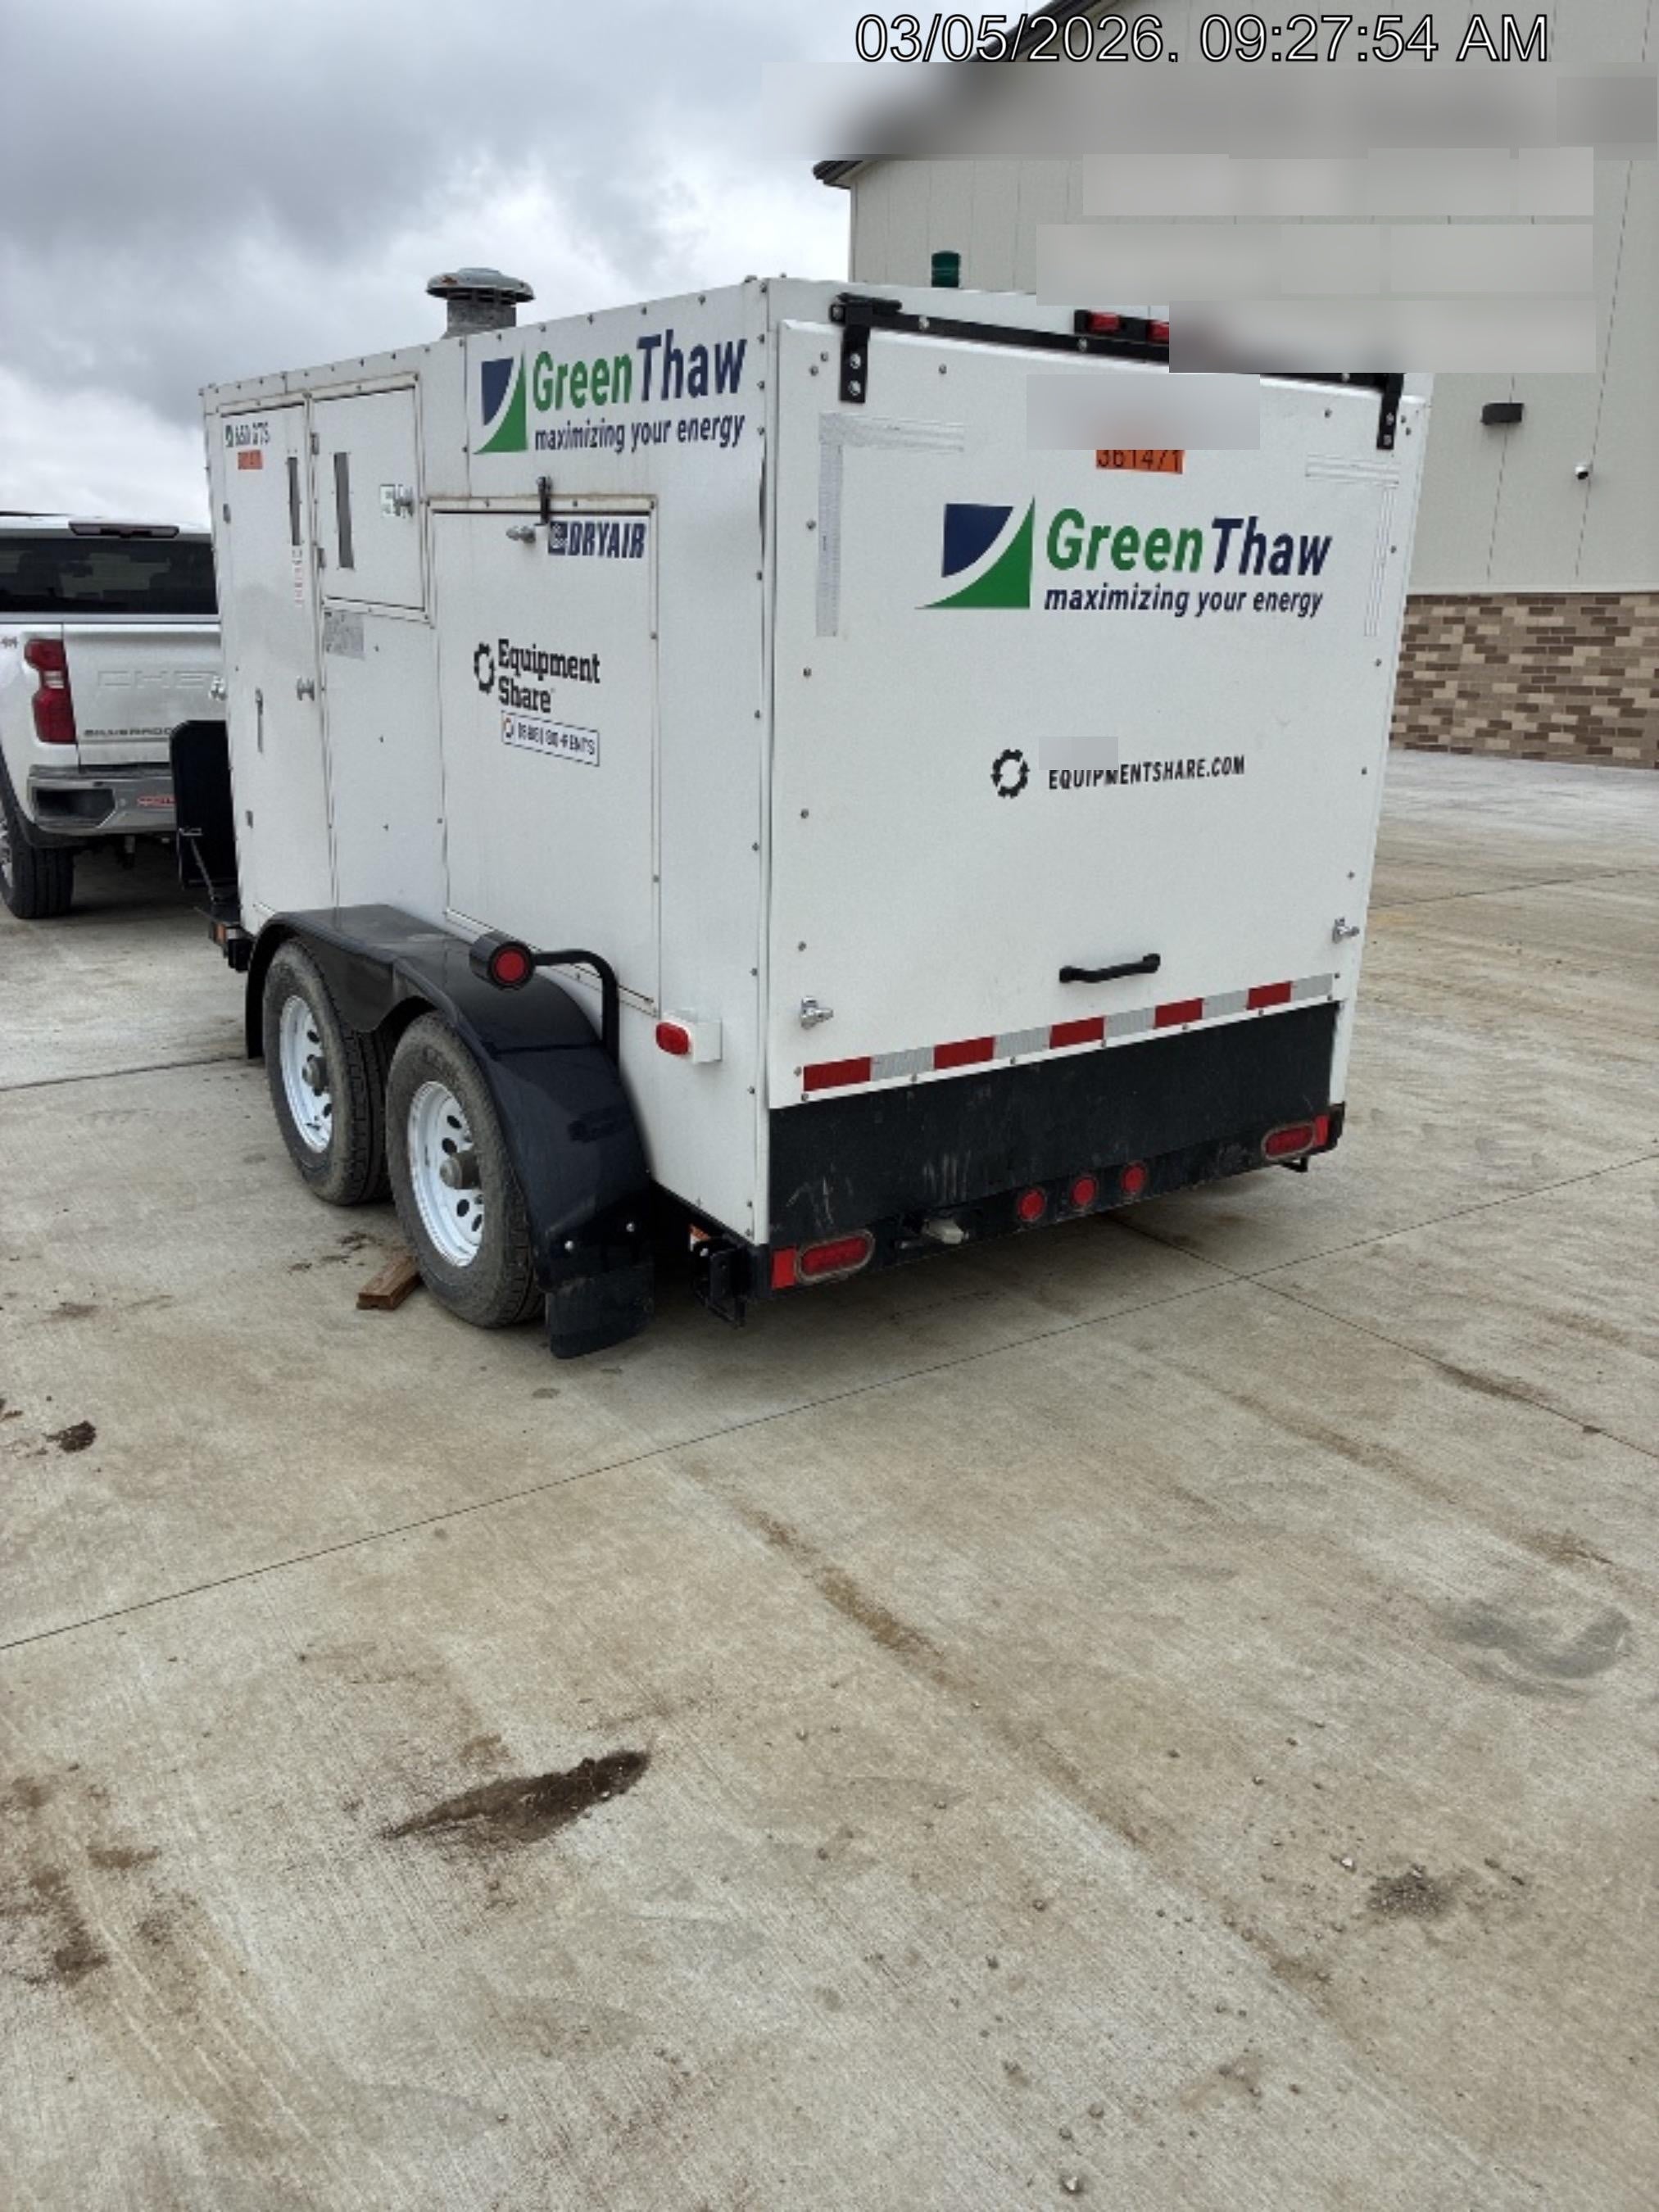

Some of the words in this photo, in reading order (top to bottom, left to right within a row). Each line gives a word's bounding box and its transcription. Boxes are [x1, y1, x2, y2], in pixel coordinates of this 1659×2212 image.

[535, 418, 625, 455] maximizing
[631, 419, 671, 452] your
[678, 415, 746, 447] energy
[569, 522, 646, 558] DRYAIR
[1044, 582, 1190, 618] maximizing
[1195, 592, 1247, 618] your
[1253, 593, 1323, 618] energy
[498, 638, 601, 683] Equipment
[498, 676, 551, 714] Share
[1049, 755, 1244, 790] EQUIPMENTSHARE.COM
